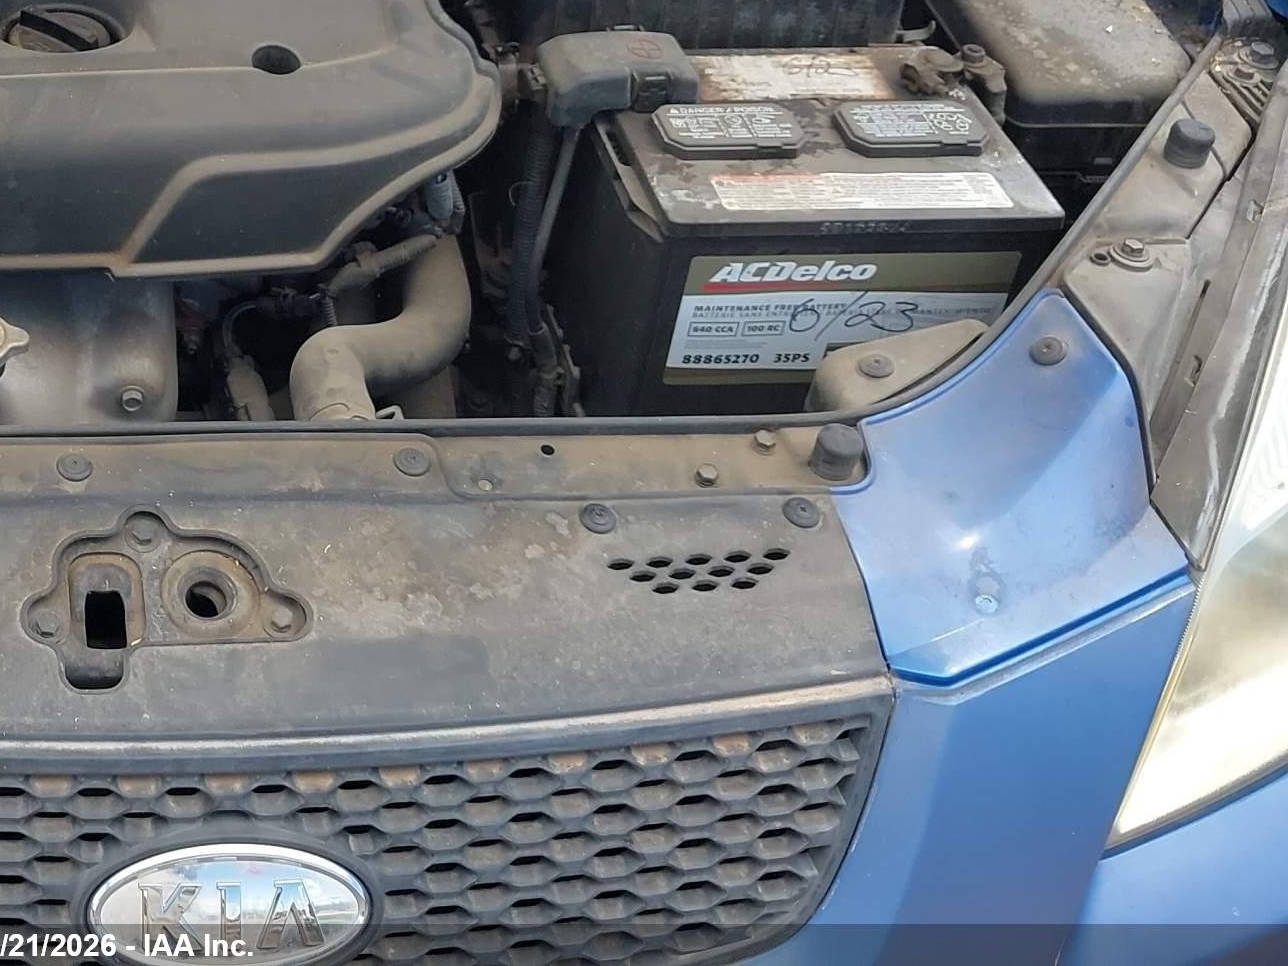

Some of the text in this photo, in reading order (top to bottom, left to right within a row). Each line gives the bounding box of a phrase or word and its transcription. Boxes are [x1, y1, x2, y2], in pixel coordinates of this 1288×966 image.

[708, 260, 878, 283] ACDelco
[693, 305, 771, 313] MAINTENANCE
[789, 291, 919, 342] 6/23
[714, 325, 734, 333] CCA
[746, 325, 765, 333] 100
[682, 353, 811, 365] 88865270 35PS
[137, 879, 326, 952] KIA
